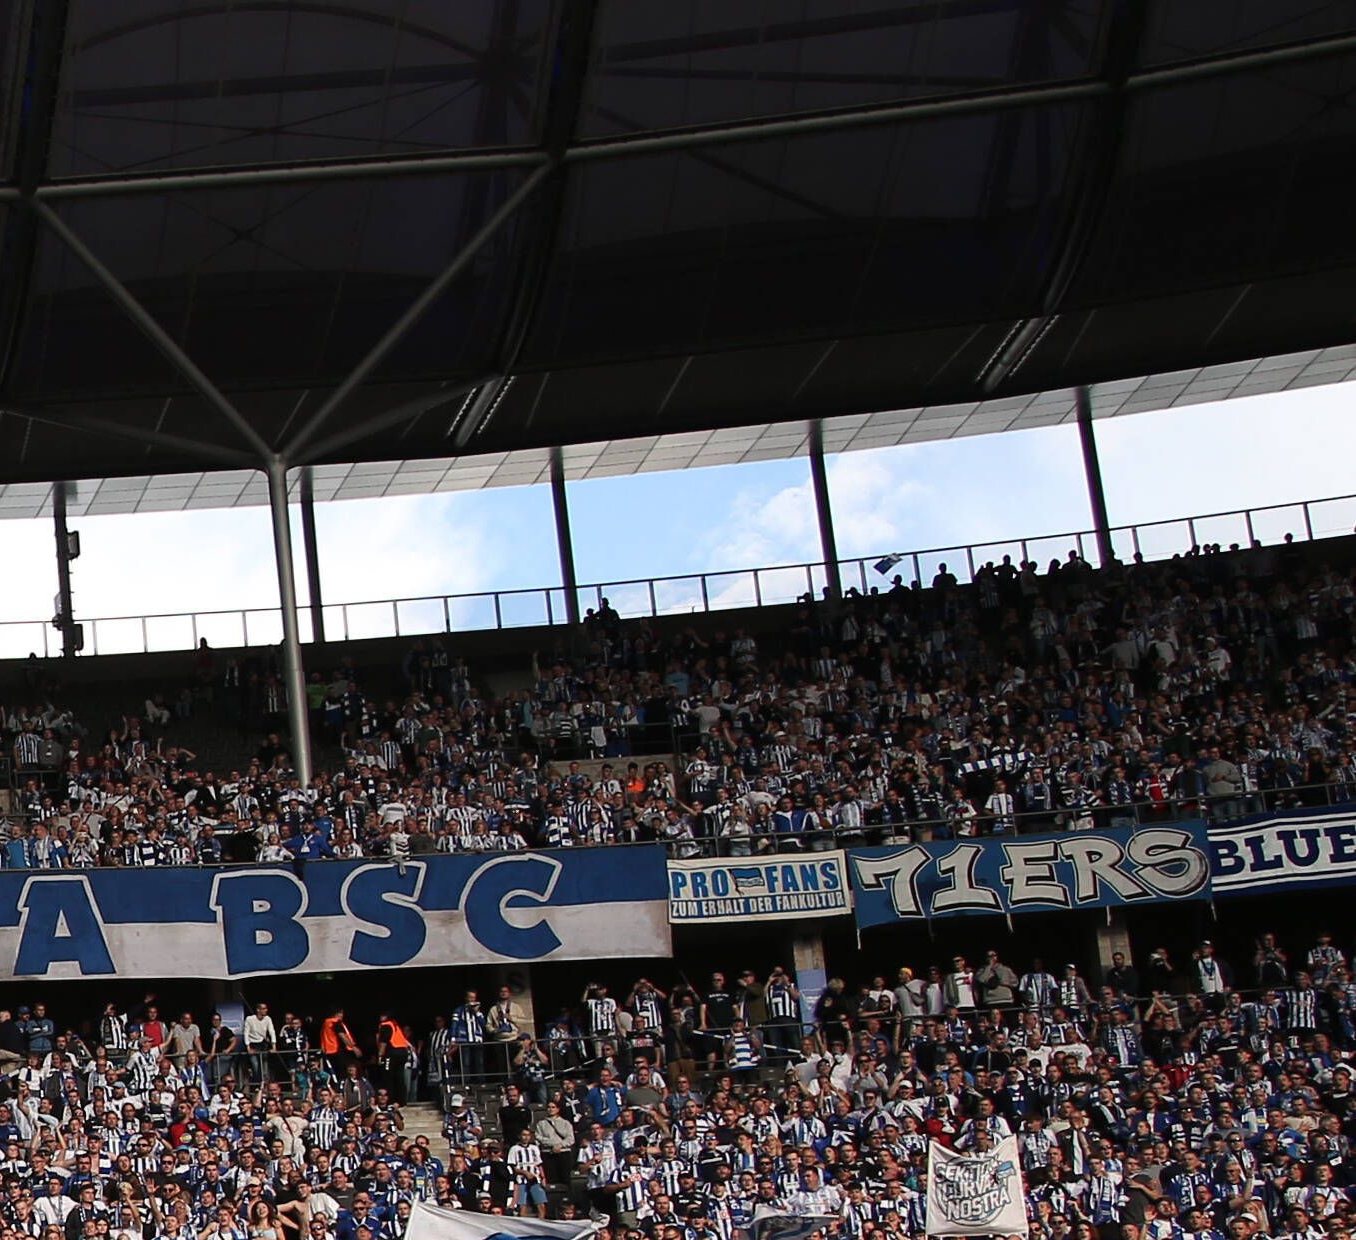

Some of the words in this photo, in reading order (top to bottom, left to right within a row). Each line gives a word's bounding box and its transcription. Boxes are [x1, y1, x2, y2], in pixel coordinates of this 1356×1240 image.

[670, 868, 729, 899] PRO
[764, 861, 840, 893] FANS
[857, 828, 1210, 918] 71ERS
[210, 852, 563, 976] BSC
[672, 900, 698, 917] ZUM
[702, 898, 745, 916] ERHALT
[749, 896, 774, 913] DER
[776, 890, 846, 911] FANKULTUR
[947, 1187, 1011, 1220] NOSTRA
